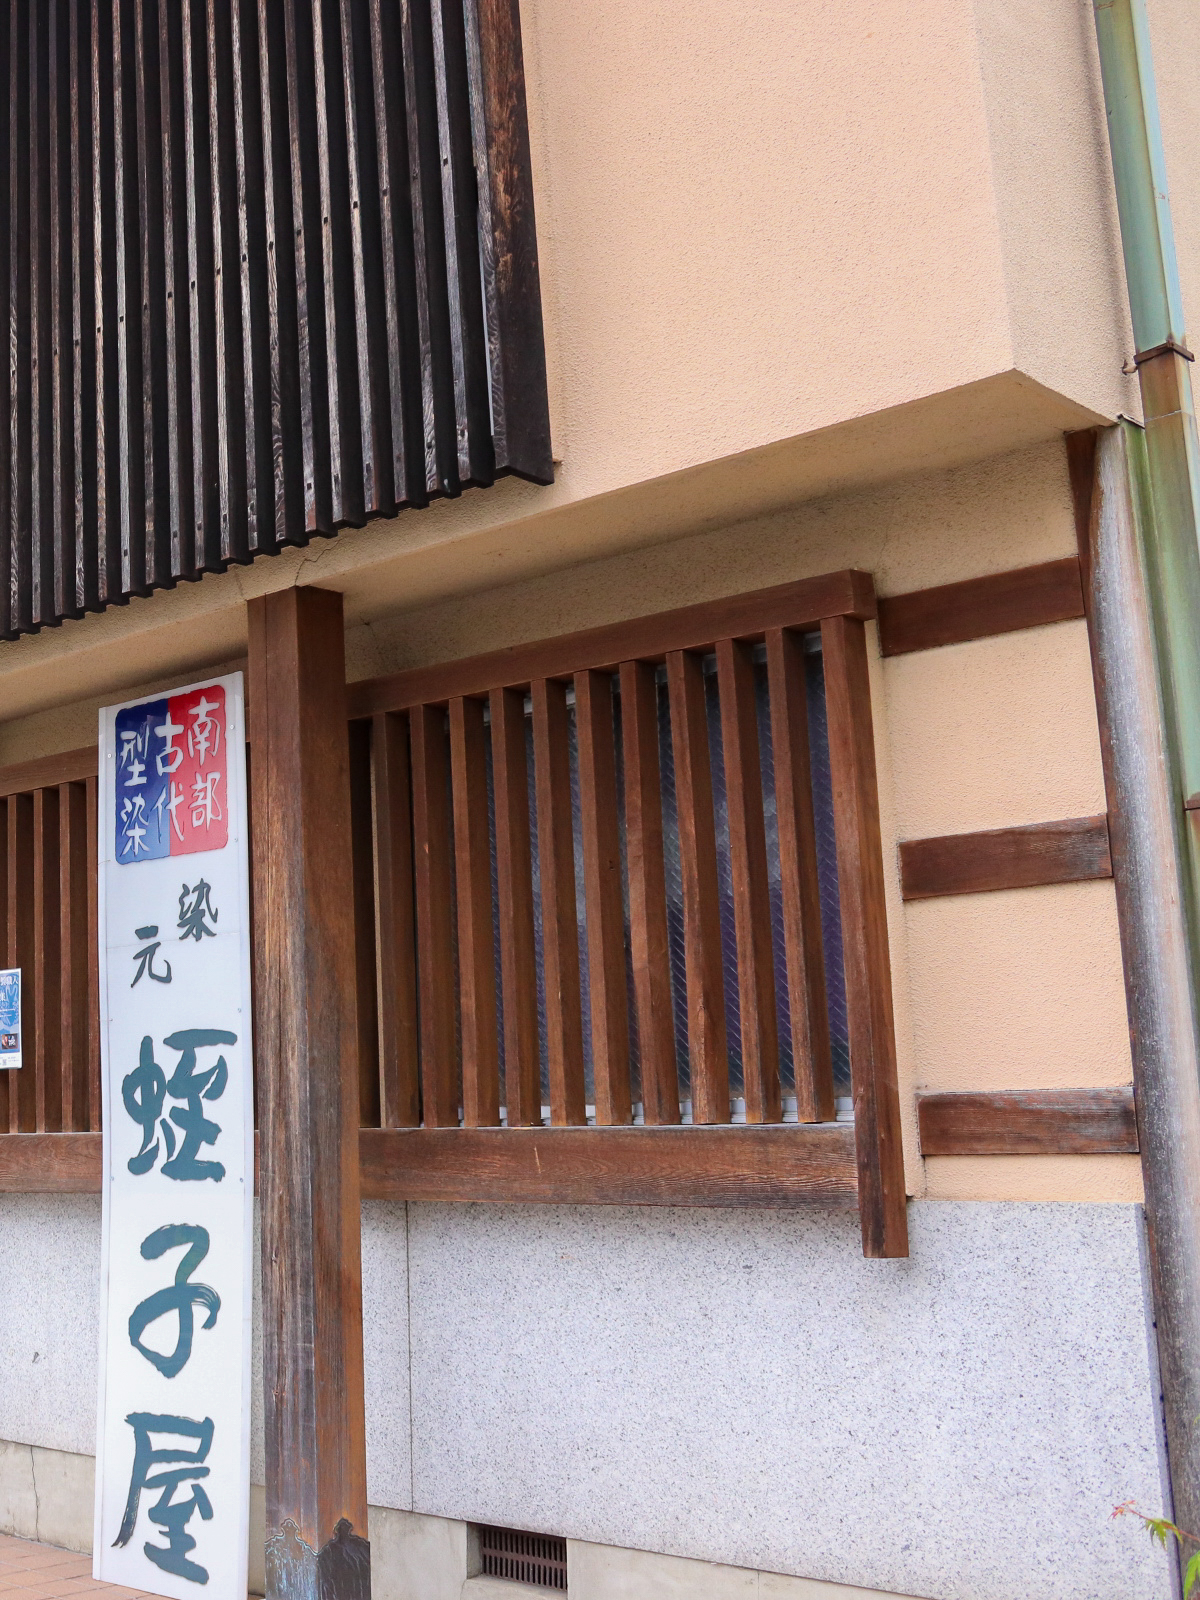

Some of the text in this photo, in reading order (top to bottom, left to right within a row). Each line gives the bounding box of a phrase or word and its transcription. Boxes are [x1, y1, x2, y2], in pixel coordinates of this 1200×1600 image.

[119, 724, 150, 857] 型染
[151, 711, 185, 844] 古代
[187, 696, 222, 830] 南部
[130, 877, 218, 988] 染元
[110, 1028, 238, 1585] 蛭子屋
